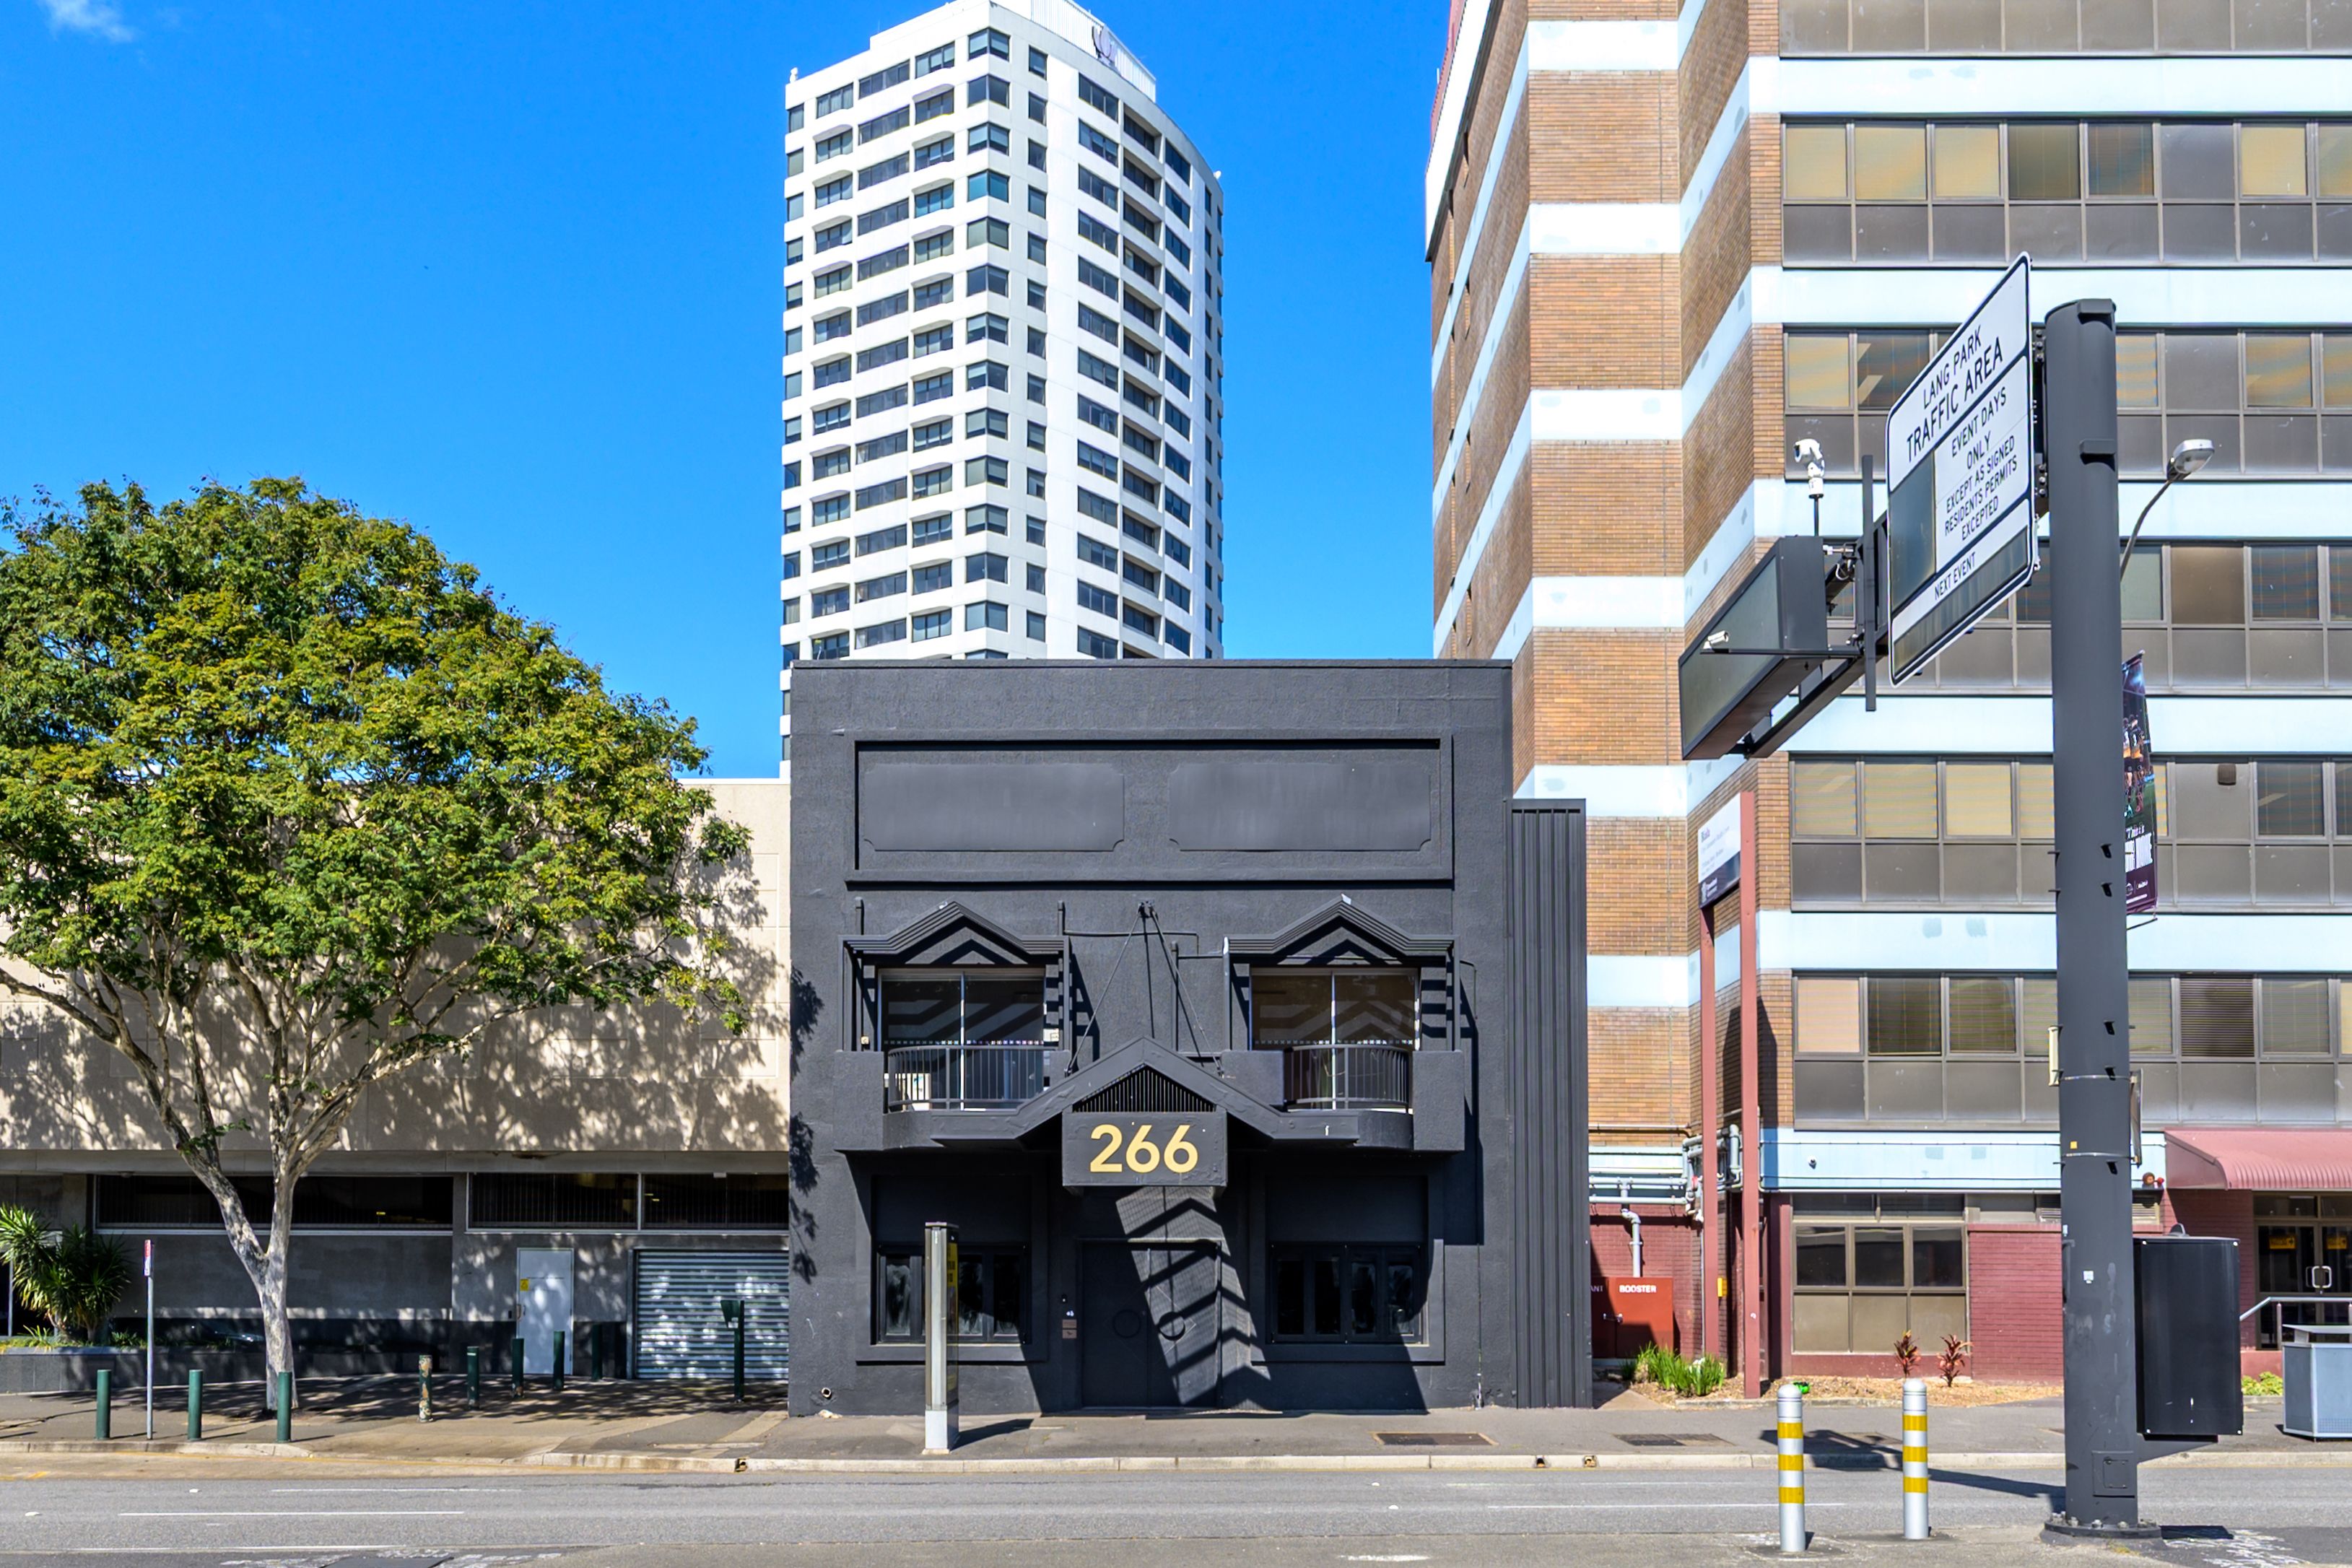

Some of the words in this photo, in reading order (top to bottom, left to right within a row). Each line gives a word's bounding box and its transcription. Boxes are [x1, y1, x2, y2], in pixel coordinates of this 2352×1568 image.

[1924, 363, 1949, 409] LANG
[1954, 325, 1981, 375] PARK
[1907, 384, 1959, 462] TRAFFIC
[1964, 336, 2003, 401] AREA
[1952, 414, 1978, 458] EVENT
[1982, 386, 2005, 427] DAYS
[1946, 476, 1972, 513] EXCEPT
[1975, 464, 1985, 487] AS
[1987, 435, 2014, 474] SIGNED
[1967, 430, 1991, 470] ONLY
[1945, 488, 1983, 536] RESIDENTS
[1985, 454, 2017, 498] PERMITS
[1961, 496, 1998, 541] EXCEPTED
[1935, 573, 1951, 601] NEXT
[1954, 552, 1976, 583] EVENT
[1089, 1123, 1198, 1173] 266
[1619, 1284, 1657, 1293] BOOSTER
